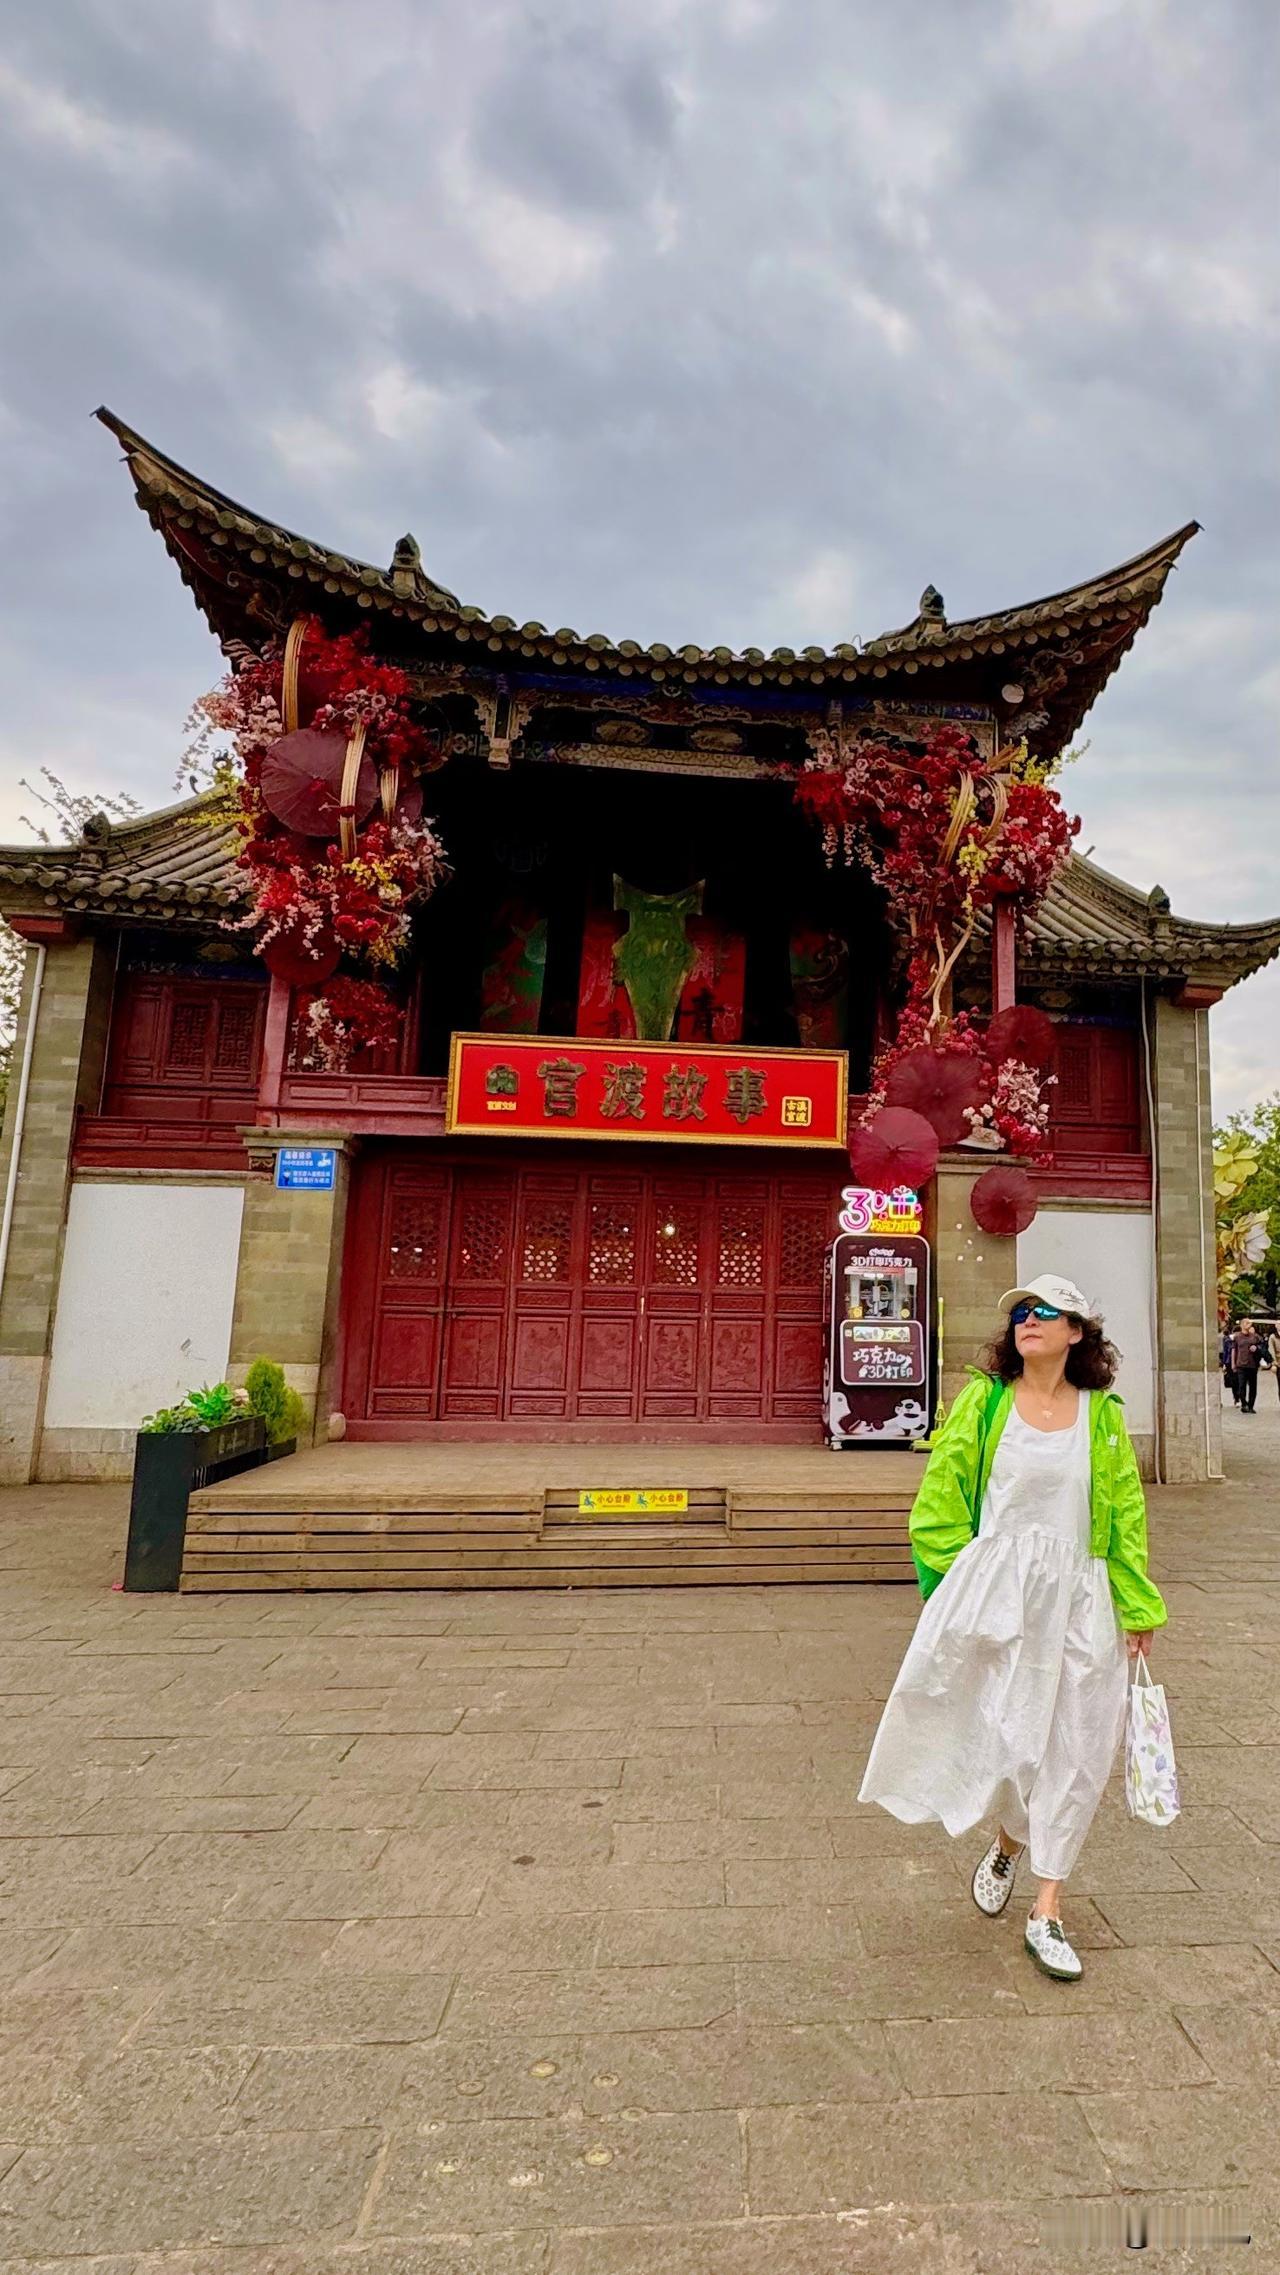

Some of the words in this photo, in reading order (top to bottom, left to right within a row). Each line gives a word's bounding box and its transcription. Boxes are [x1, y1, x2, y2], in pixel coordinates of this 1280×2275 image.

[537, 1057, 768, 1123] 官渡故事
[851, 1256, 912, 1266] 3D打印巧克力
